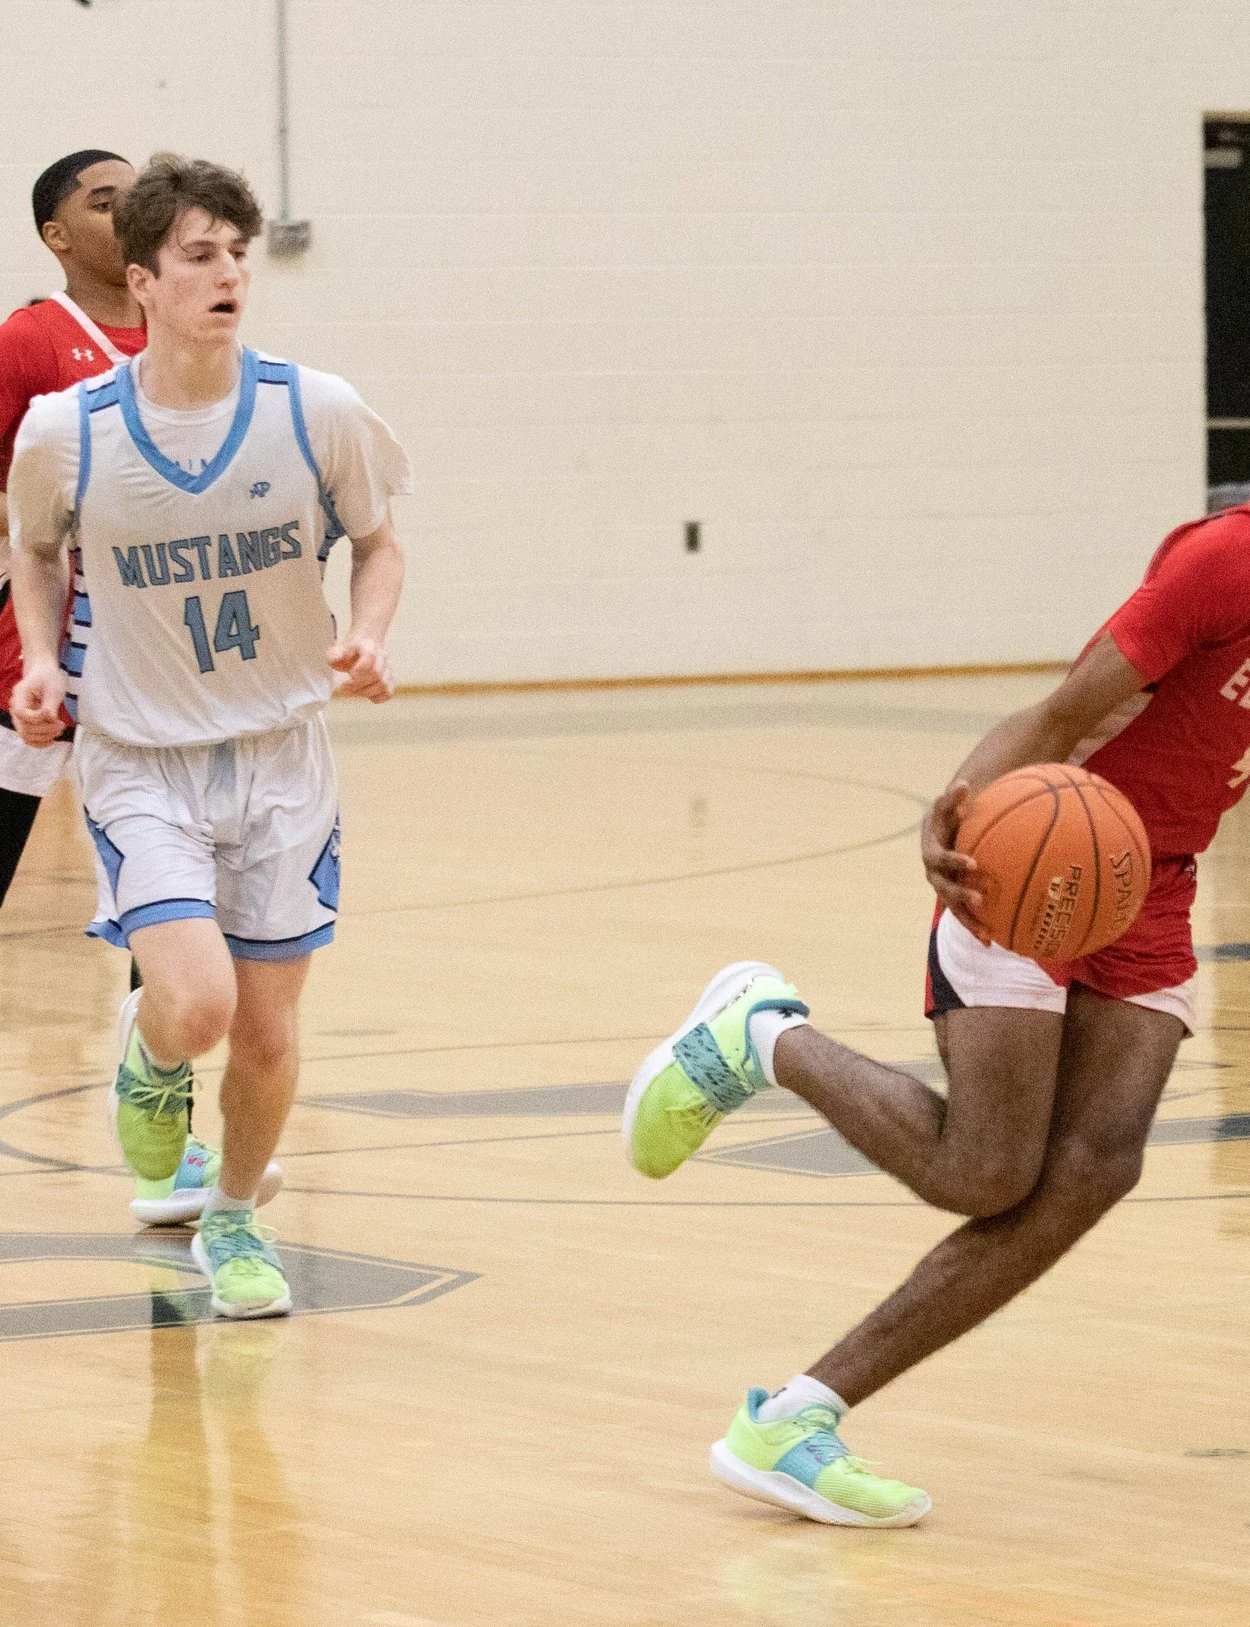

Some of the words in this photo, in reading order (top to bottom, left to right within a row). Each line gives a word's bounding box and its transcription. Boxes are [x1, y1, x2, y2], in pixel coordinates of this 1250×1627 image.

[111, 520, 302, 590] MUSTANGS
[184, 589, 260, 674] 14
[1108, 850, 1135, 926] SPAL
